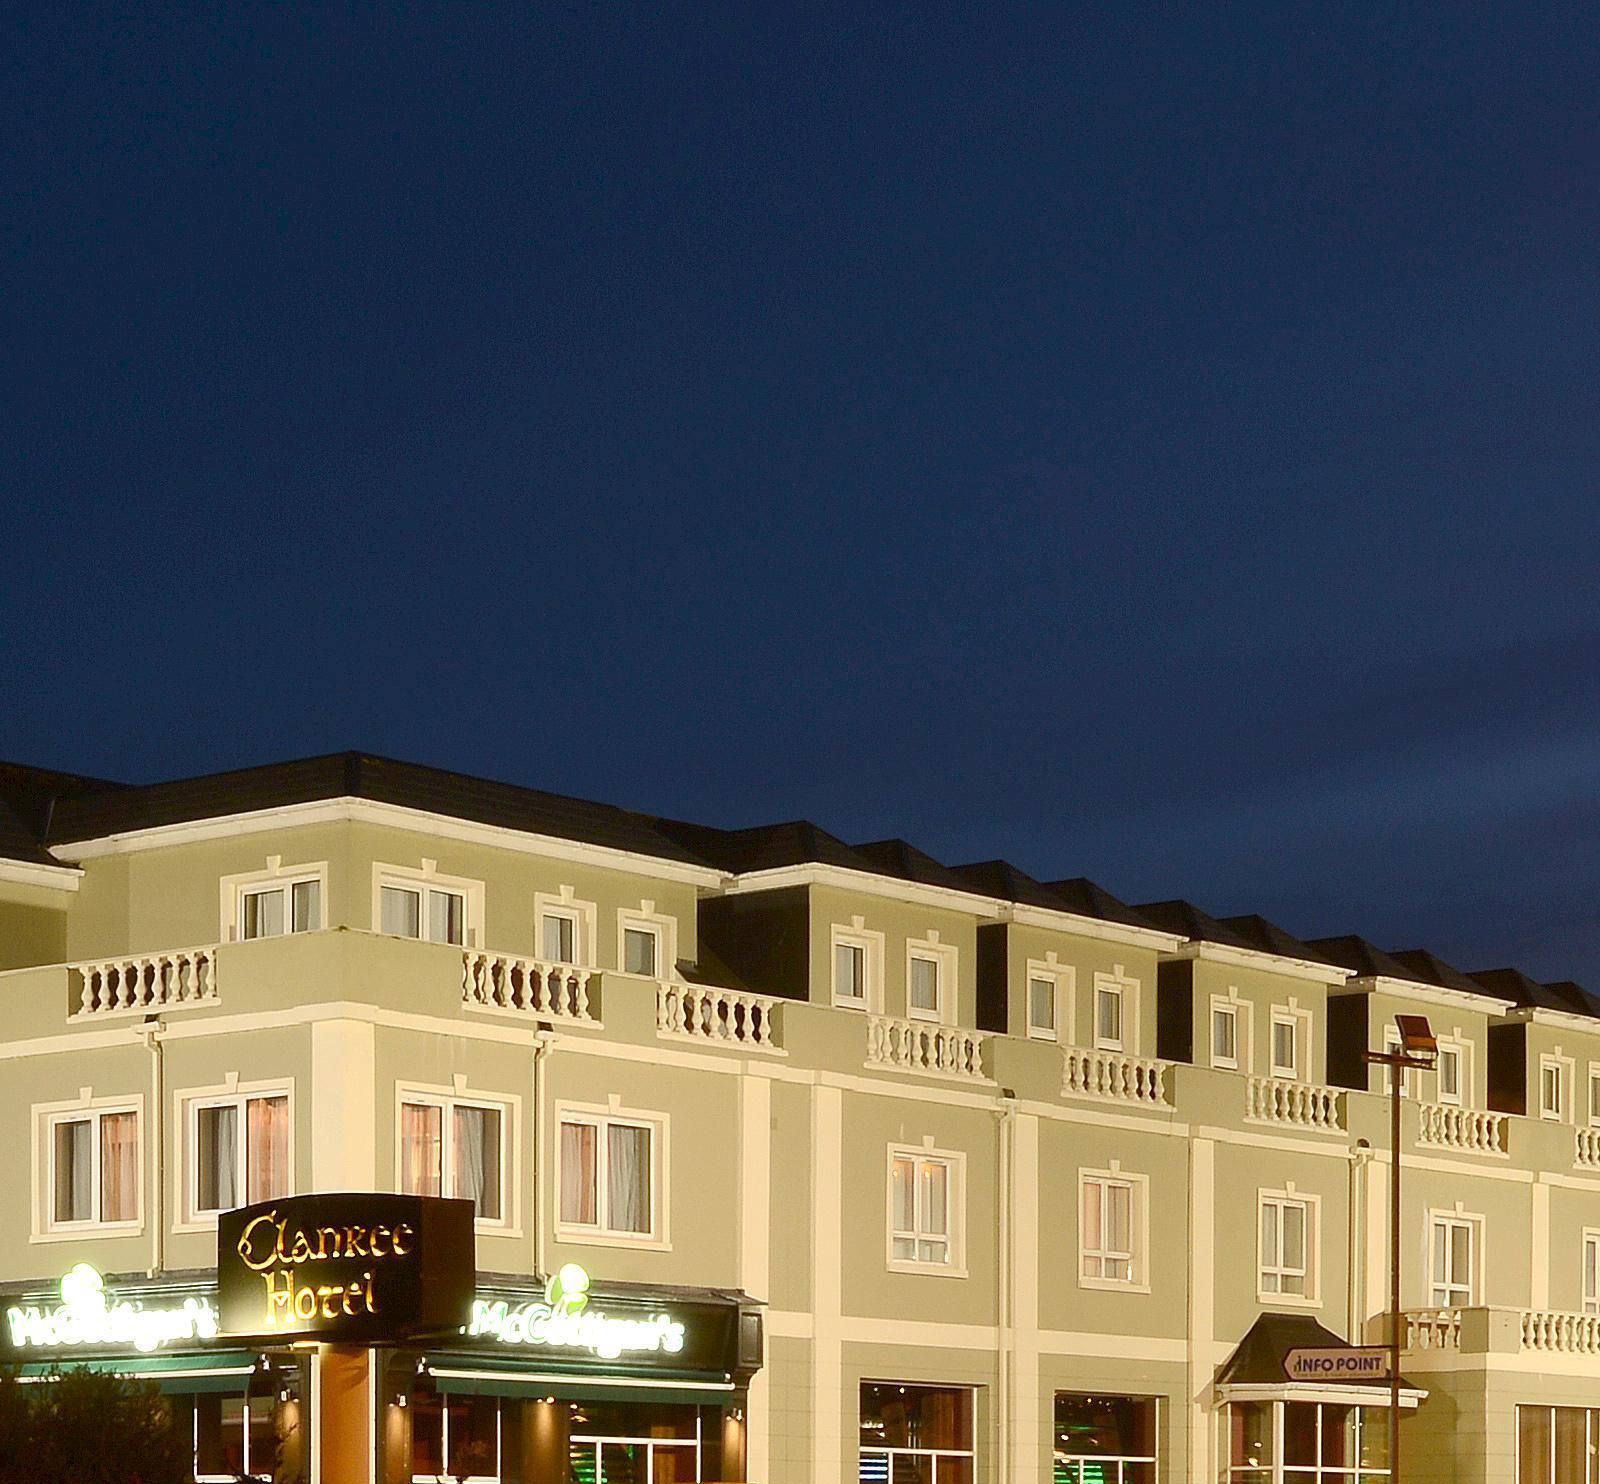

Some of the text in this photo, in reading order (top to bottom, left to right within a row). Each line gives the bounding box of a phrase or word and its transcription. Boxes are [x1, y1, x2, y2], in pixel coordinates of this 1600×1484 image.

[237, 1209, 414, 1270] Clanree
[261, 1268, 377, 1325] Hotel
[1336, 1356, 1382, 1371] POINT
